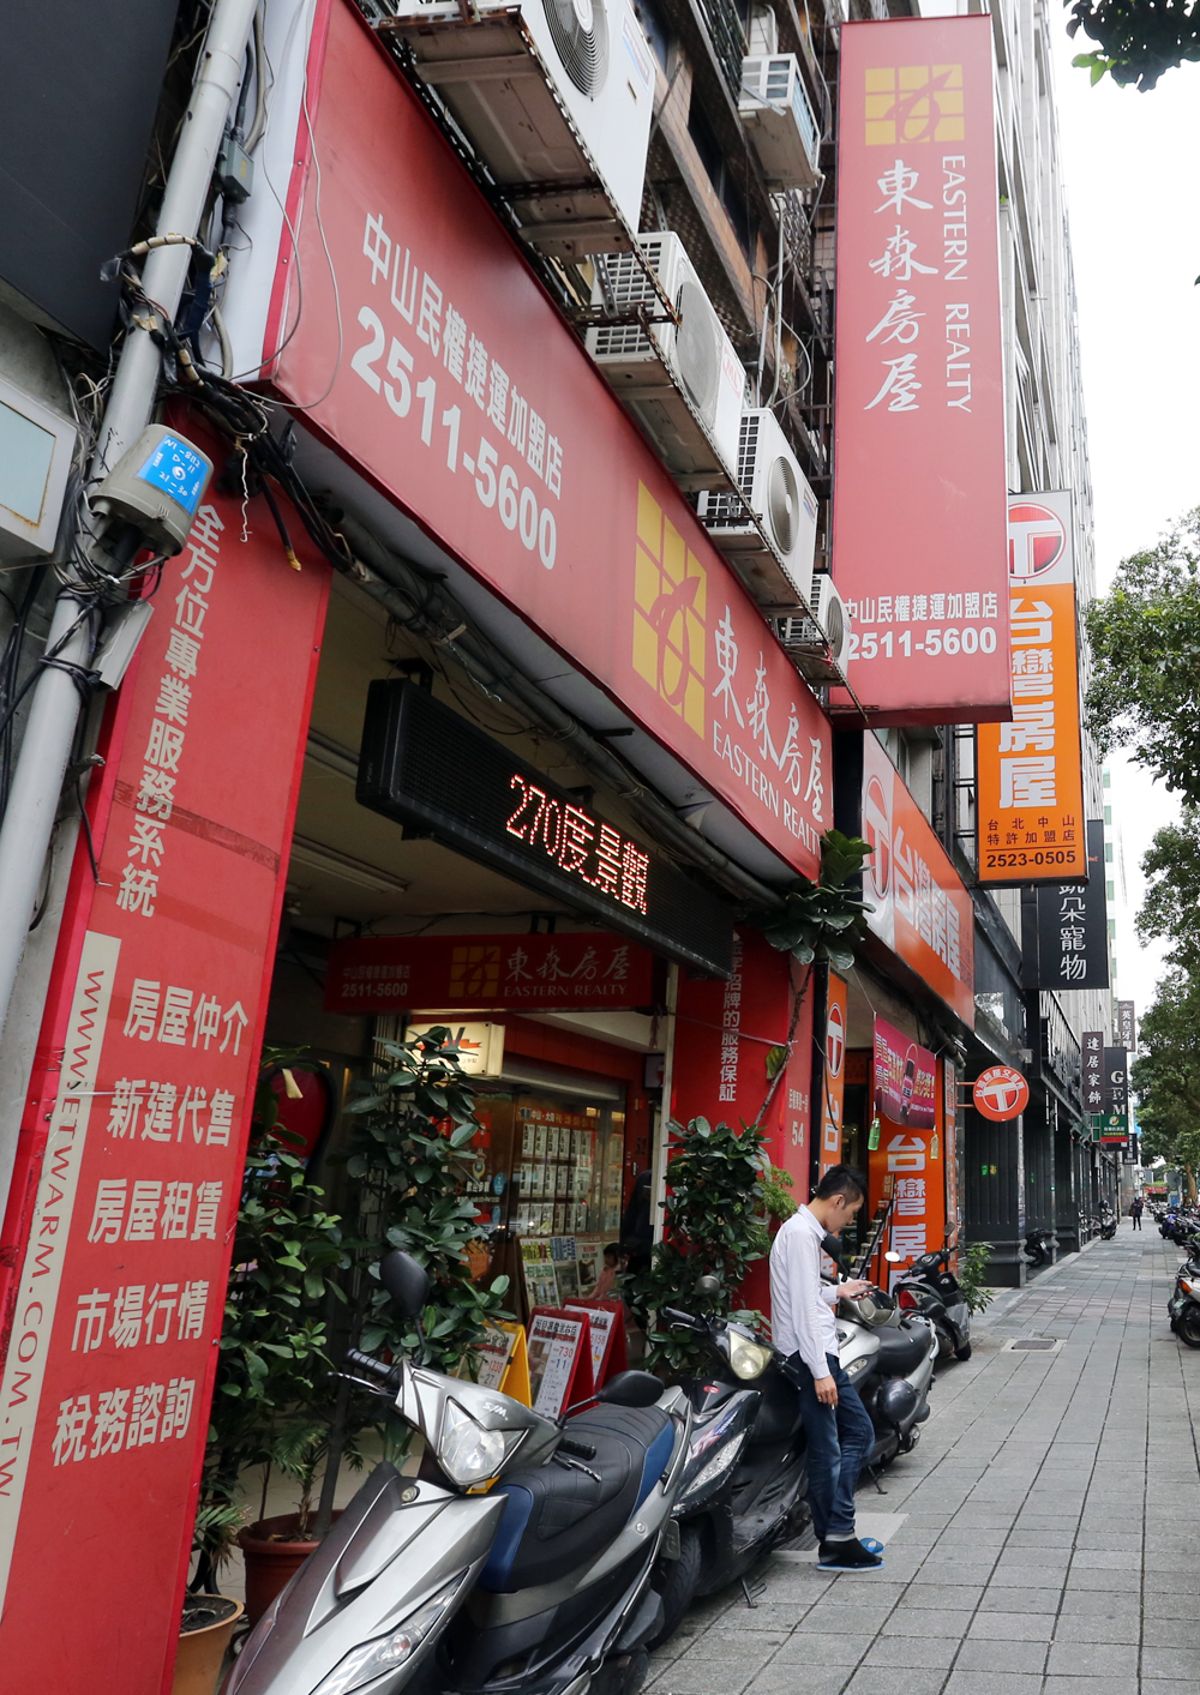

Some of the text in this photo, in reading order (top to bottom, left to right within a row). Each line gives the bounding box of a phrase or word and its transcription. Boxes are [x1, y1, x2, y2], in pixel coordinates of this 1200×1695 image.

[864, 159, 939, 412] 東森房屋
[942, 155, 972, 413] EASTERN REALTY
[363, 212, 563, 500] 中山民權捷運加盟店
[350, 306, 557, 570] 2511-5600
[845, 591, 998, 624] 中山民權捷運加盟店
[848, 626, 998, 661] 2511-5600
[116, 503, 226, 918] 全方位專業服務系統
[713, 605, 823, 823] 東森房屋
[713, 720, 780, 818] EASTERN
[987, 829, 1075, 846] 特許加盟店
[987, 851, 1076, 868] 2523-0505
[988, 815, 1075, 831] 台北中山
[893, 826, 962, 982] 台灣房屋
[341, 982, 408, 998] 2511-5600
[503, 983, 627, 998] EASTERN REALTY
[505, 945, 631, 981] 東森房屋
[123, 978, 248, 1056] 房屋仲介
[107, 1079, 236, 1147] 新建代售
[87, 1177, 223, 1245] 房屋租賃
[887, 1134, 927, 1300] 台灣房
[71, 1281, 209, 1354] 市場行情
[52, 1376, 196, 1467] 稅務諮詢
